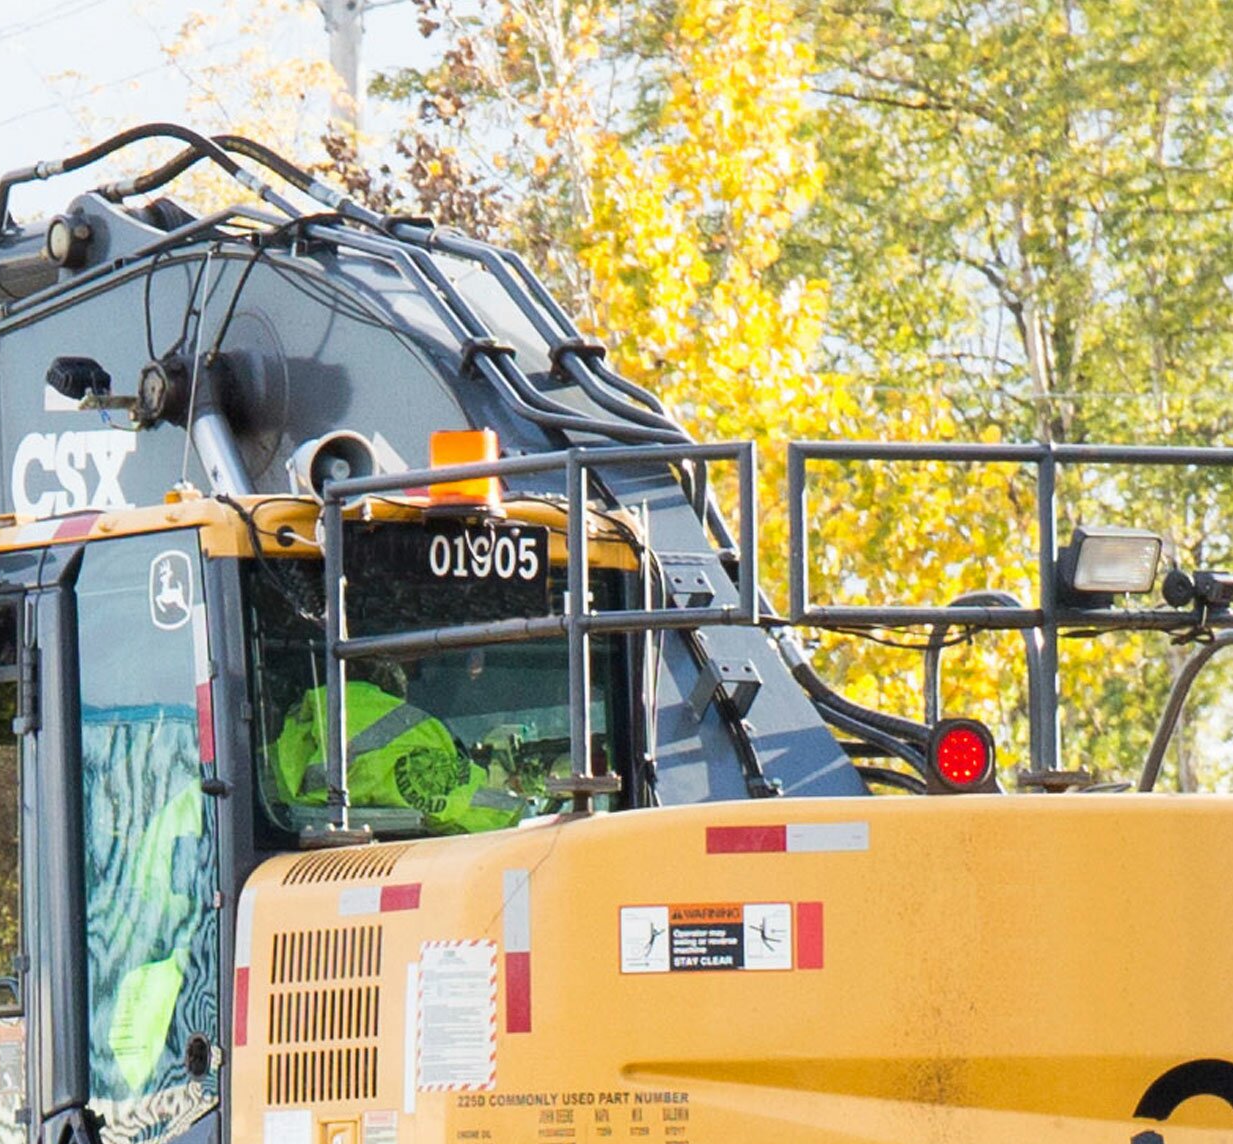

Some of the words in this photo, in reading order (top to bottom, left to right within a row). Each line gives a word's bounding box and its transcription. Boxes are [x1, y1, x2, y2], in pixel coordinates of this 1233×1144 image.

[12, 430, 136, 517] CSX
[430, 535, 538, 580] 01905
[673, 957, 699, 967] STAY
[700, 955, 733, 965] CLEAR
[489, 1093, 557, 1107] COMMONLY
[562, 1092, 595, 1105] USED
[598, 1092, 630, 1105] PART
[635, 1091, 689, 1104] NUMBER
